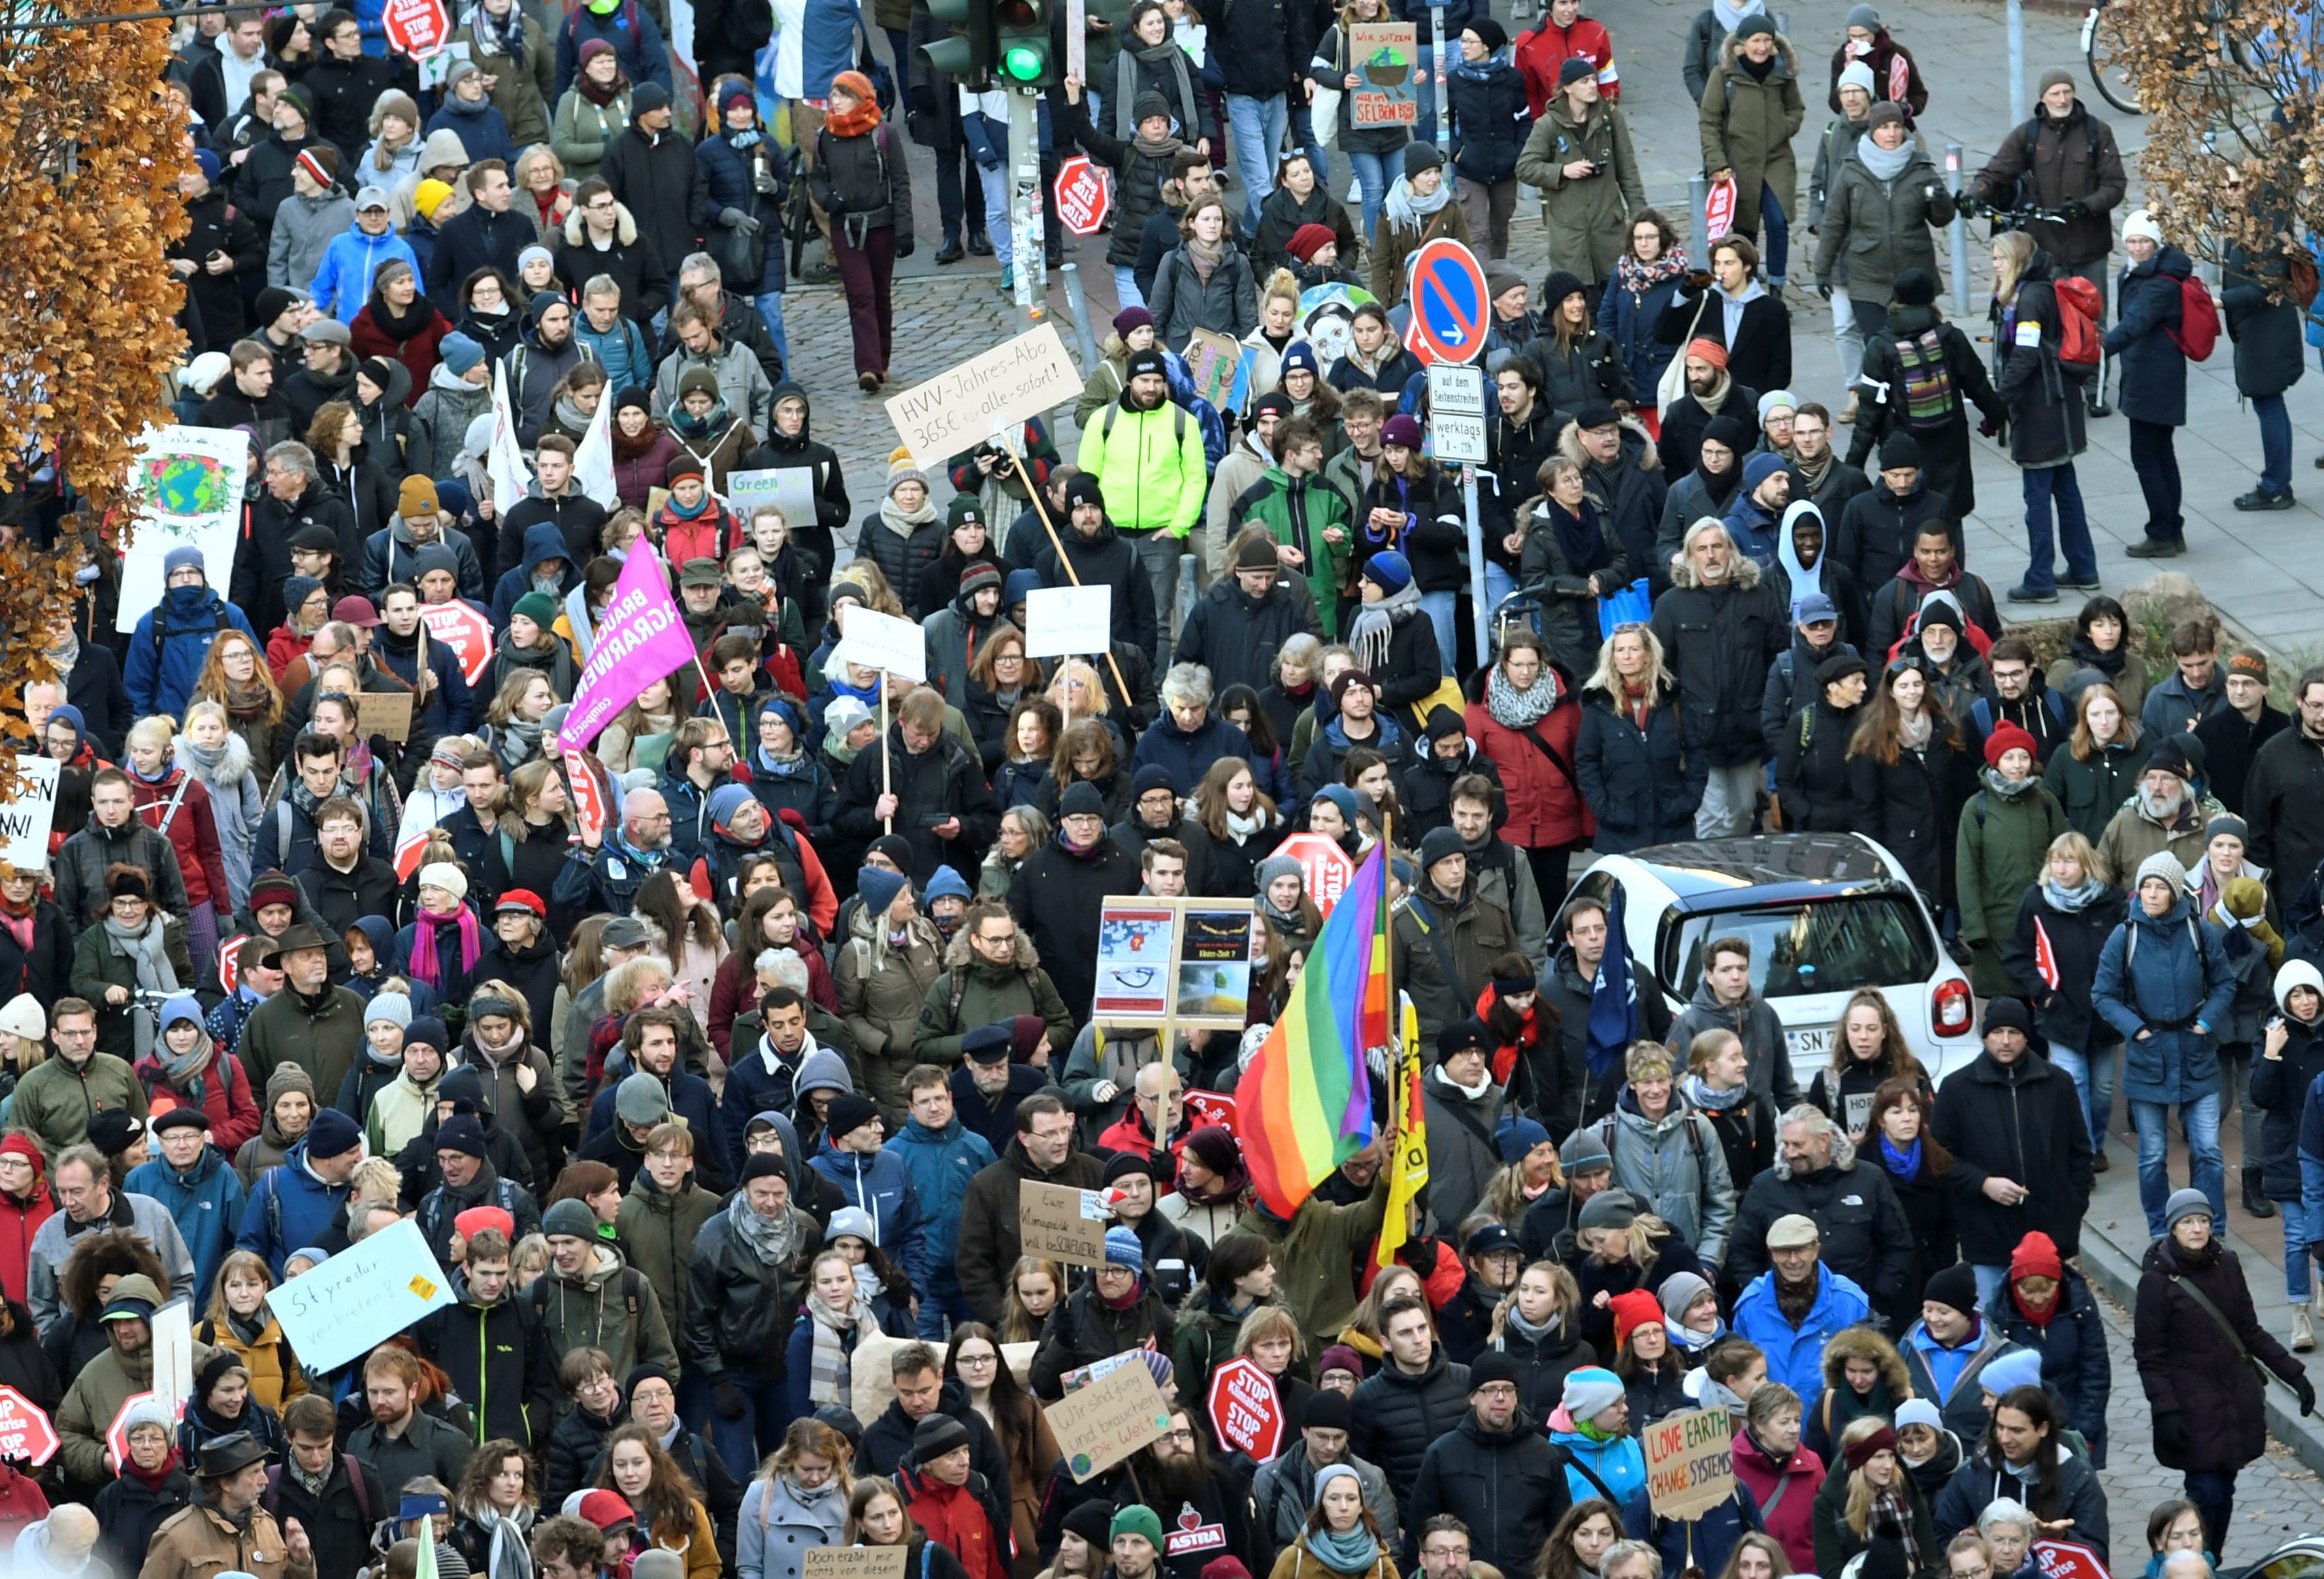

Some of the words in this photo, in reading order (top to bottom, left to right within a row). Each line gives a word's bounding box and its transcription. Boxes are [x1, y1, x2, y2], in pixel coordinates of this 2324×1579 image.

[404, 15, 432, 37] STOP
[1356, 32, 1374, 41] WIR
[1072, 181, 1096, 206] STOP
[1062, 202, 1085, 227] STOP
[900, 341, 1047, 423] HVV-Jahres-Abo
[1441, 375, 1452, 386] auf
[1456, 376, 1469, 388] dem
[1434, 389, 1480, 405] Seitenstreifen
[913, 411, 960, 449] 365€
[1436, 421, 1481, 441] werktags
[1446, 440, 1450, 451] 8
[733, 474, 778, 491] Green
[423, 609, 462, 629] STOP
[1326, 862, 1343, 905] STOP
[1801, 1032, 1823, 1051] SN
[1042, 1190, 1066, 1209] Eure
[1021, 1207, 1070, 1233] Klimapolitik
[1077, 1223, 1086, 1235] ist
[1024, 1237, 1040, 1249] voll
[291, 1260, 379, 1317] Styrodur
[1236, 1368, 1269, 1403] STOP
[1053, 1405, 1085, 1430] Wir
[1090, 1383, 1114, 1412] sind
[1115, 1375, 1142, 1402] jung
[1227, 1379, 1270, 1424] Klimakrise
[1068, 1425, 1096, 1451] und
[1098, 1394, 1159, 1433] brauchen
[1227, 1401, 1261, 1436] STOP
[1088, 1441, 1113, 1461] Die
[1118, 1415, 1153, 1444] Welt
[1226, 1419, 1254, 1451] GroKo
[1650, 1424, 1683, 1464] LOVE
[1686, 1409, 1729, 1448] EARTH
[1651, 1463, 1690, 1499] CHANGE
[1690, 1450, 1733, 1487] SYSTEMS
[1170, 1530, 1221, 1550] ASTRA
[808, 1550, 834, 1564] Doch
[838, 1550, 870, 1563] erzähl
[876, 1553, 893, 1561] mir
[806, 1567, 834, 1576] nichts
[841, 1567, 857, 1575] von
[863, 1564, 898, 1575] diesem
